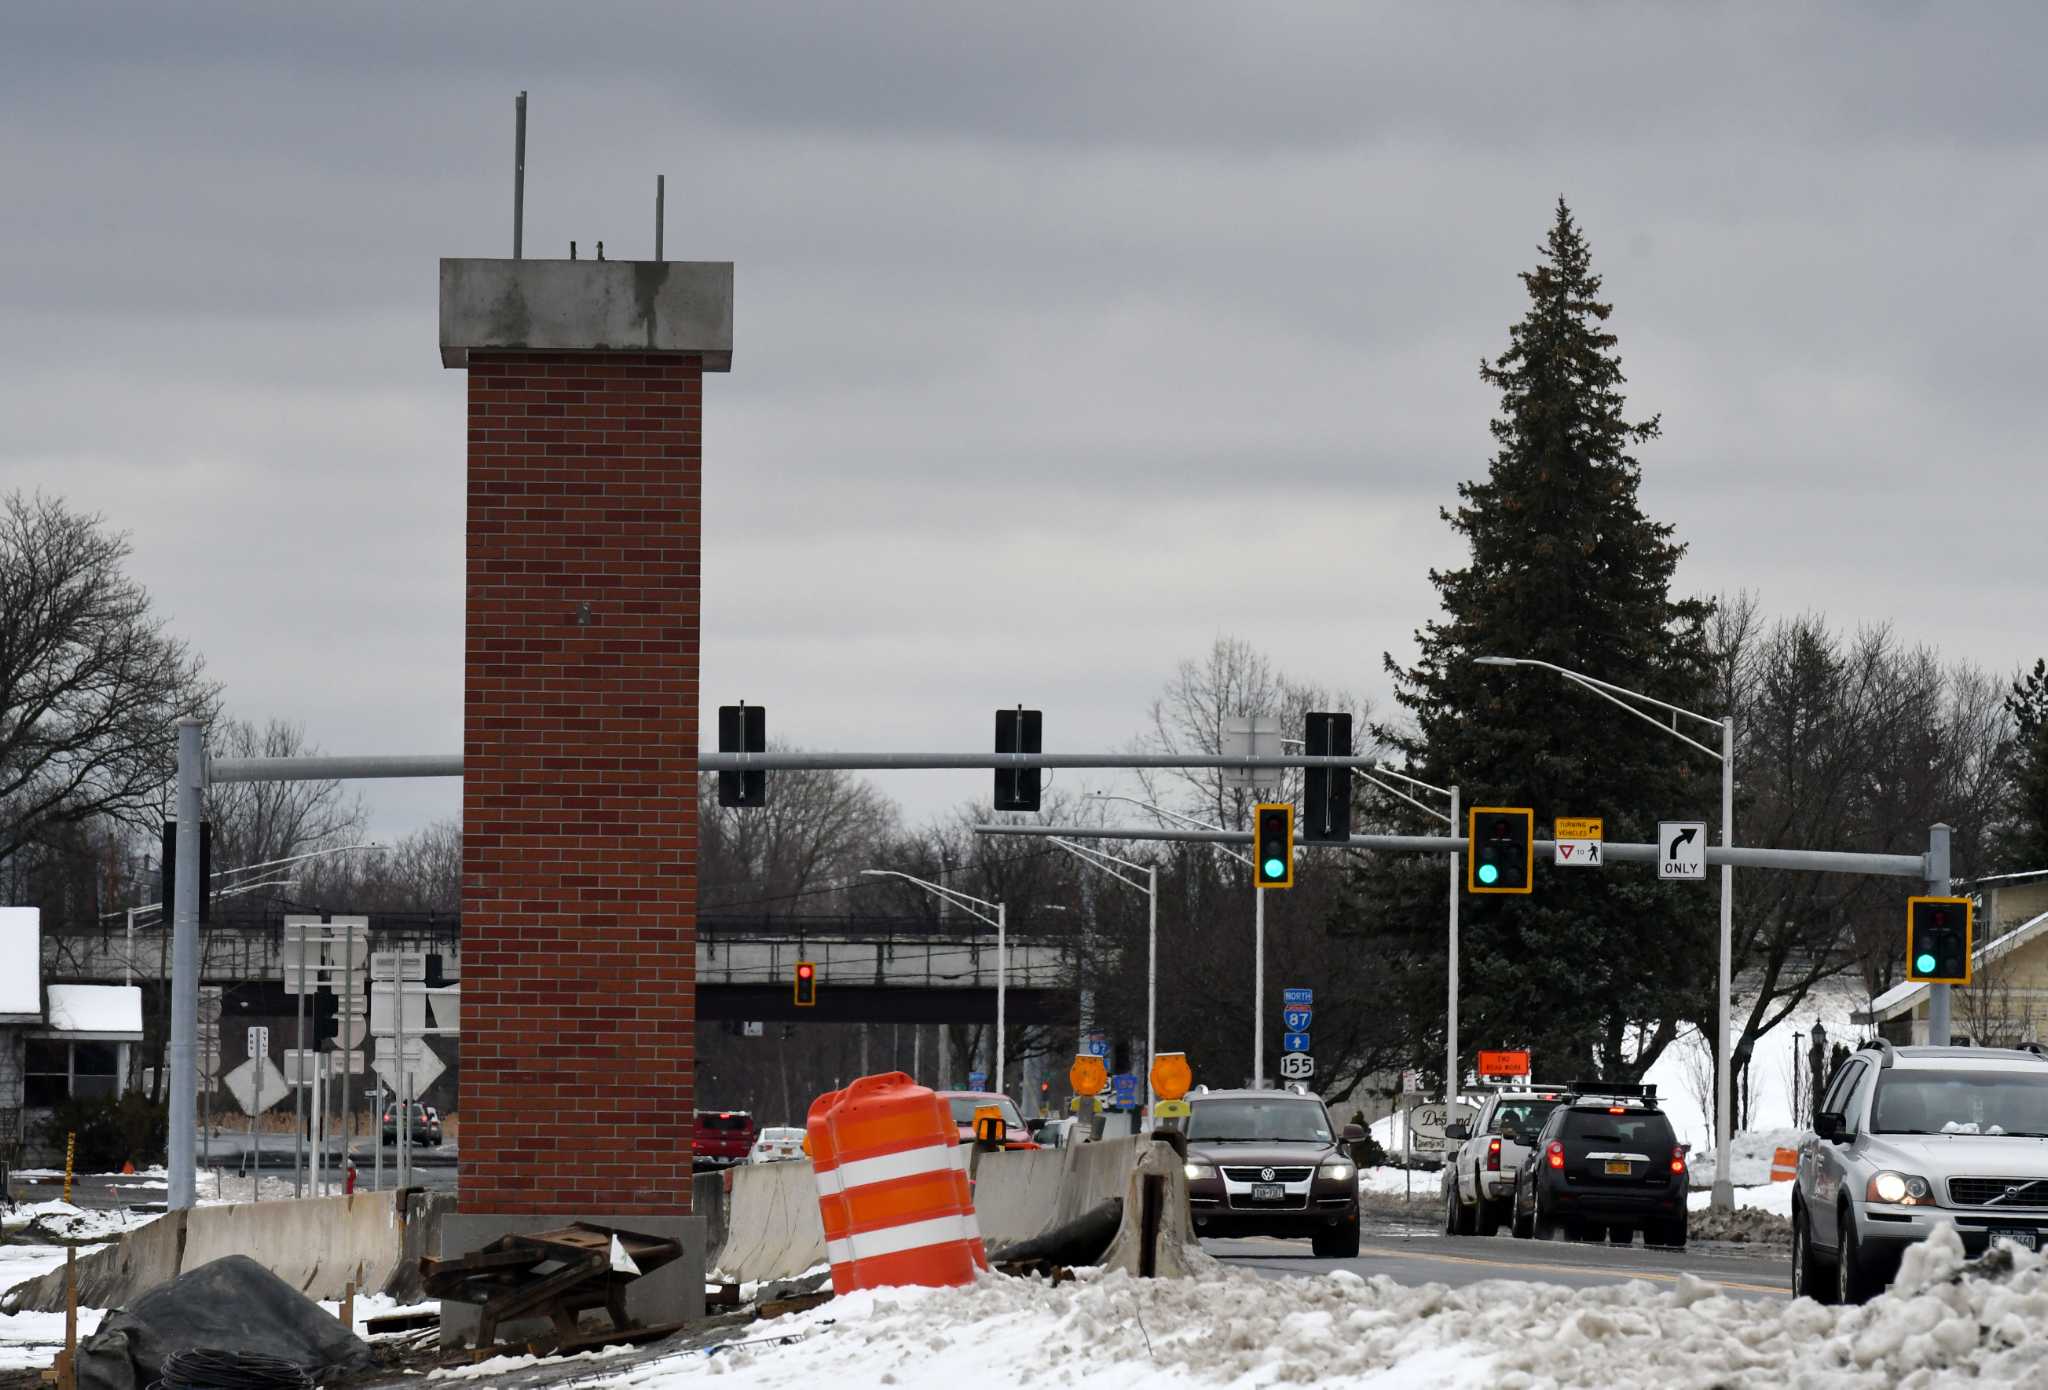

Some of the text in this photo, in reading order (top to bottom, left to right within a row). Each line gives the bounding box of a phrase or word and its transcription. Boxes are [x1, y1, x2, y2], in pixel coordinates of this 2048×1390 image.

[1664, 863, 1698, 874] ONLY
[1285, 991, 1311, 1000] NORTH
[1289, 1013, 1309, 1026] 87
[1282, 1058, 1312, 1074] 155
